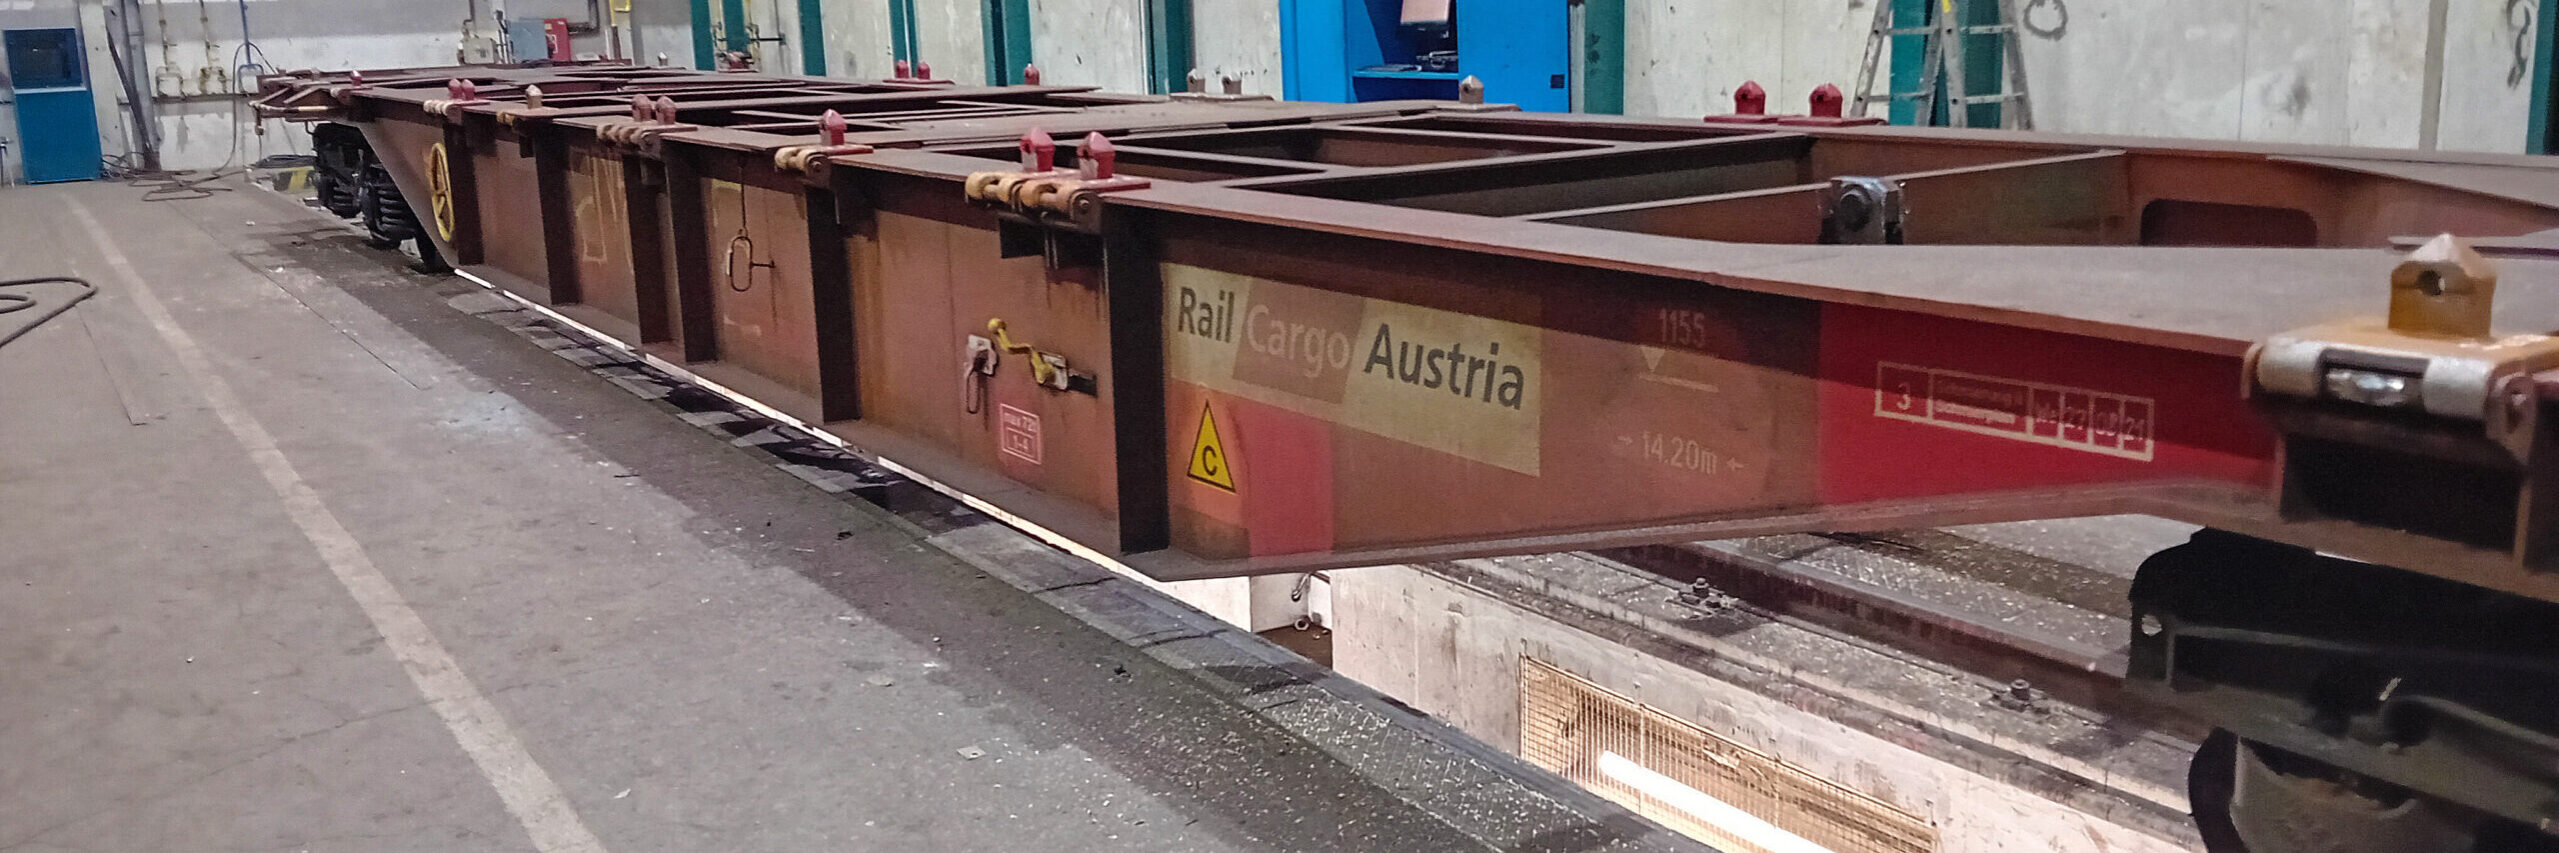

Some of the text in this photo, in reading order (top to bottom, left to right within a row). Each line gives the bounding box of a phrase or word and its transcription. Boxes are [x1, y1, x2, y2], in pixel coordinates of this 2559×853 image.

[1177, 286, 1525, 411] Rail Cargo Austria
[1896, 382, 1912, 411] 3
[1202, 445, 1218, 476] C
[1641, 431, 1719, 475] 14.20m
